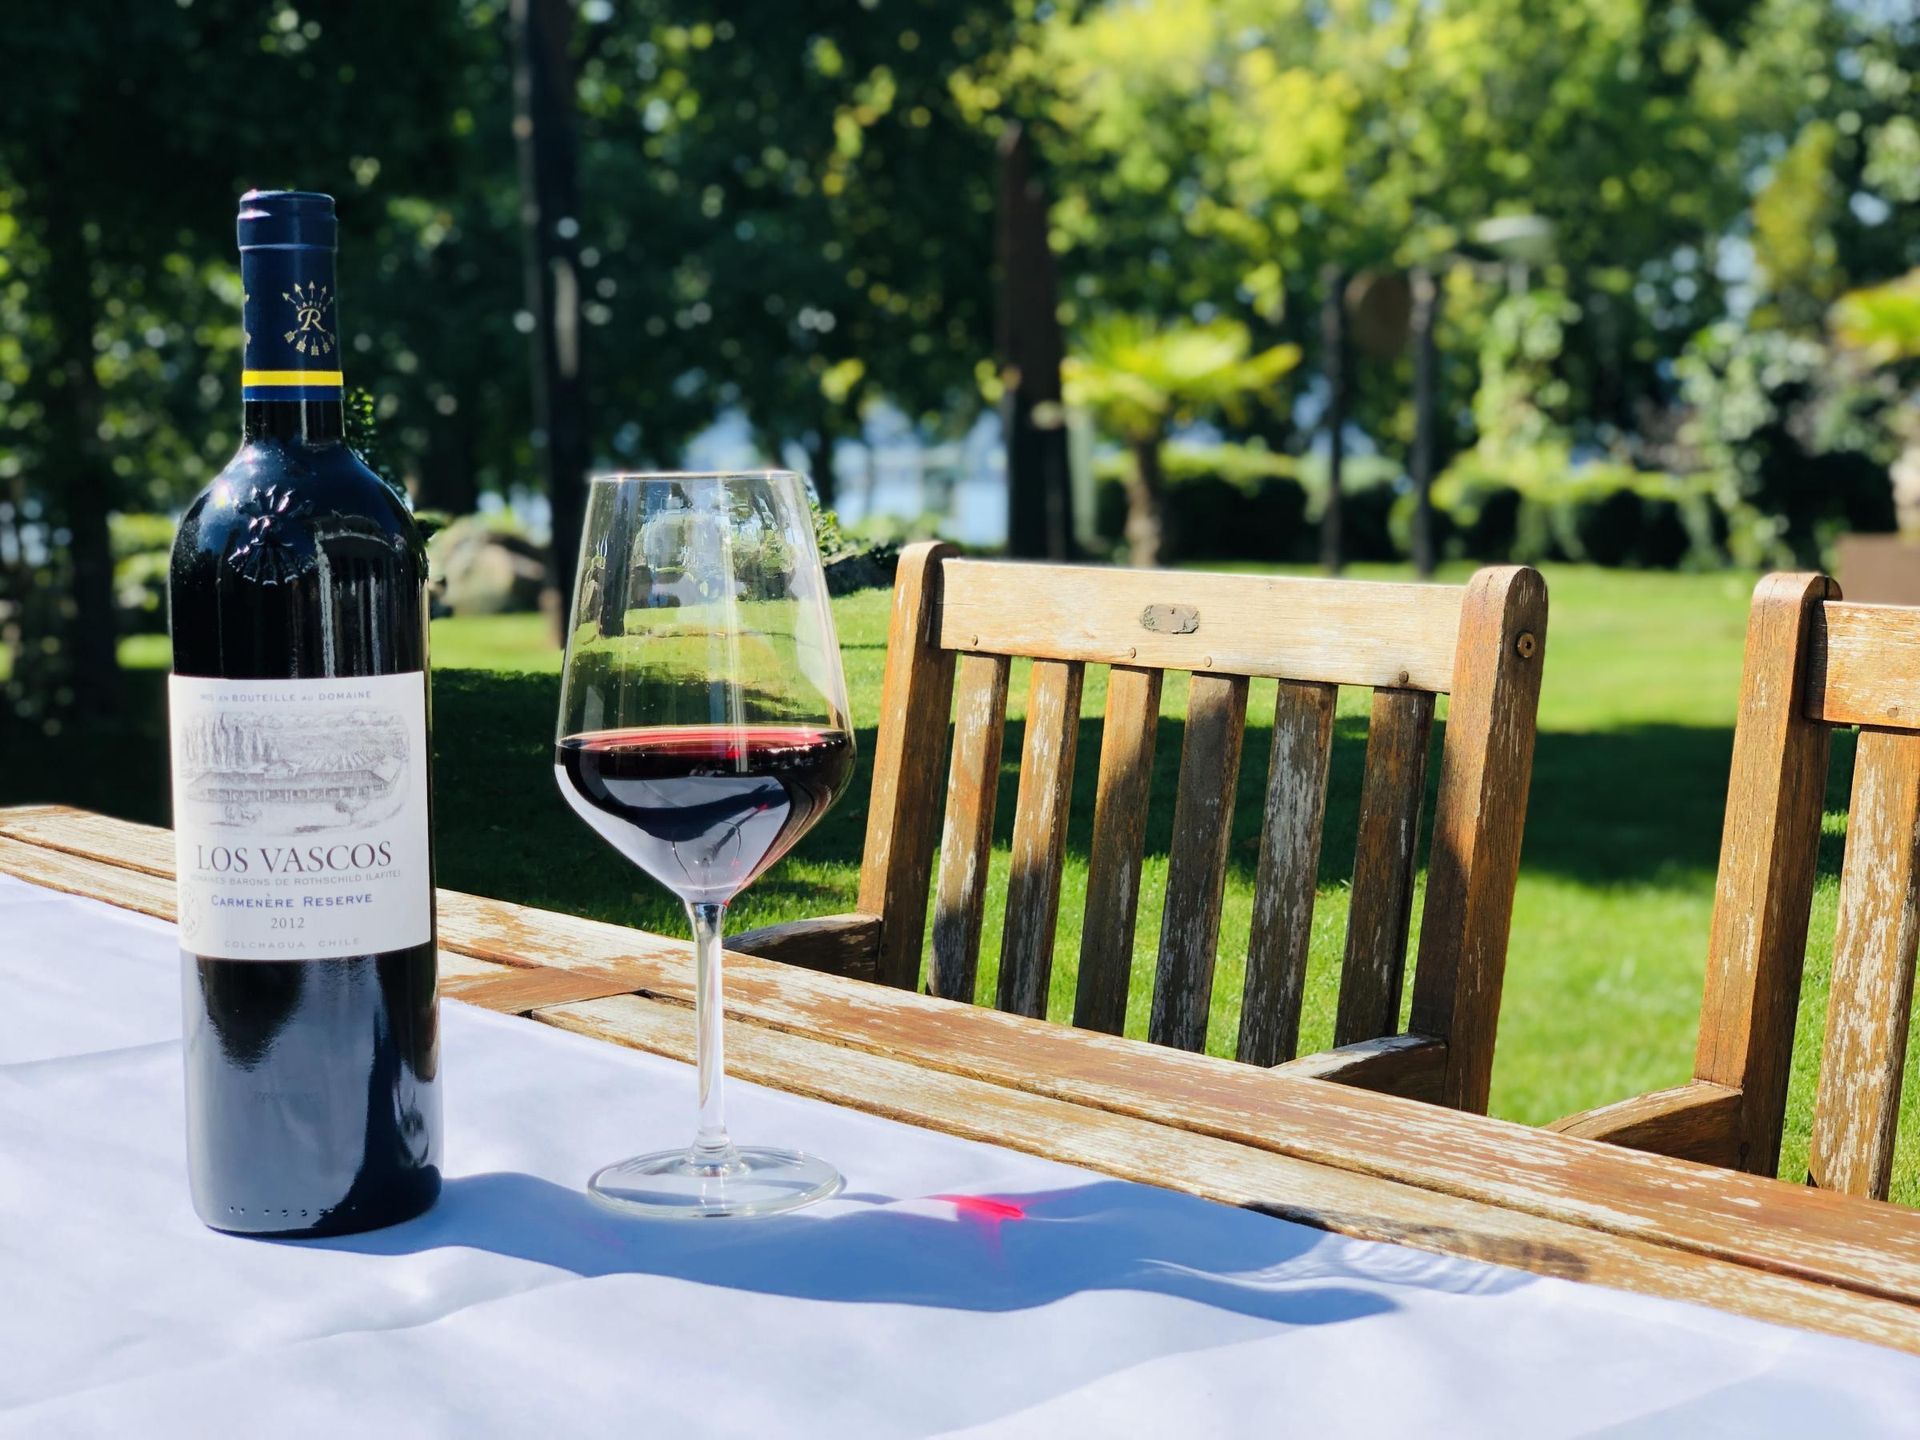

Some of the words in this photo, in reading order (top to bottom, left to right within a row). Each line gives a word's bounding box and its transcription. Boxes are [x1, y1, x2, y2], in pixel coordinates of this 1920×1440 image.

[297, 308, 327, 332] R
[231, 693, 296, 703] BOUTEILLE
[318, 691, 372, 701] DOMAINE
[196, 845, 249, 873] LOS
[259, 840, 392, 873] VASCOS
[229, 877, 270, 887] BARONS
[275, 877, 288, 887] DE
[294, 873, 362, 886] ROTHSCHILD
[303, 893, 373, 907] RESERVE
[270, 917, 305, 929] 2012
[224, 939, 306, 949] COLCHAGUA
[318, 936, 360, 948] CHILE
